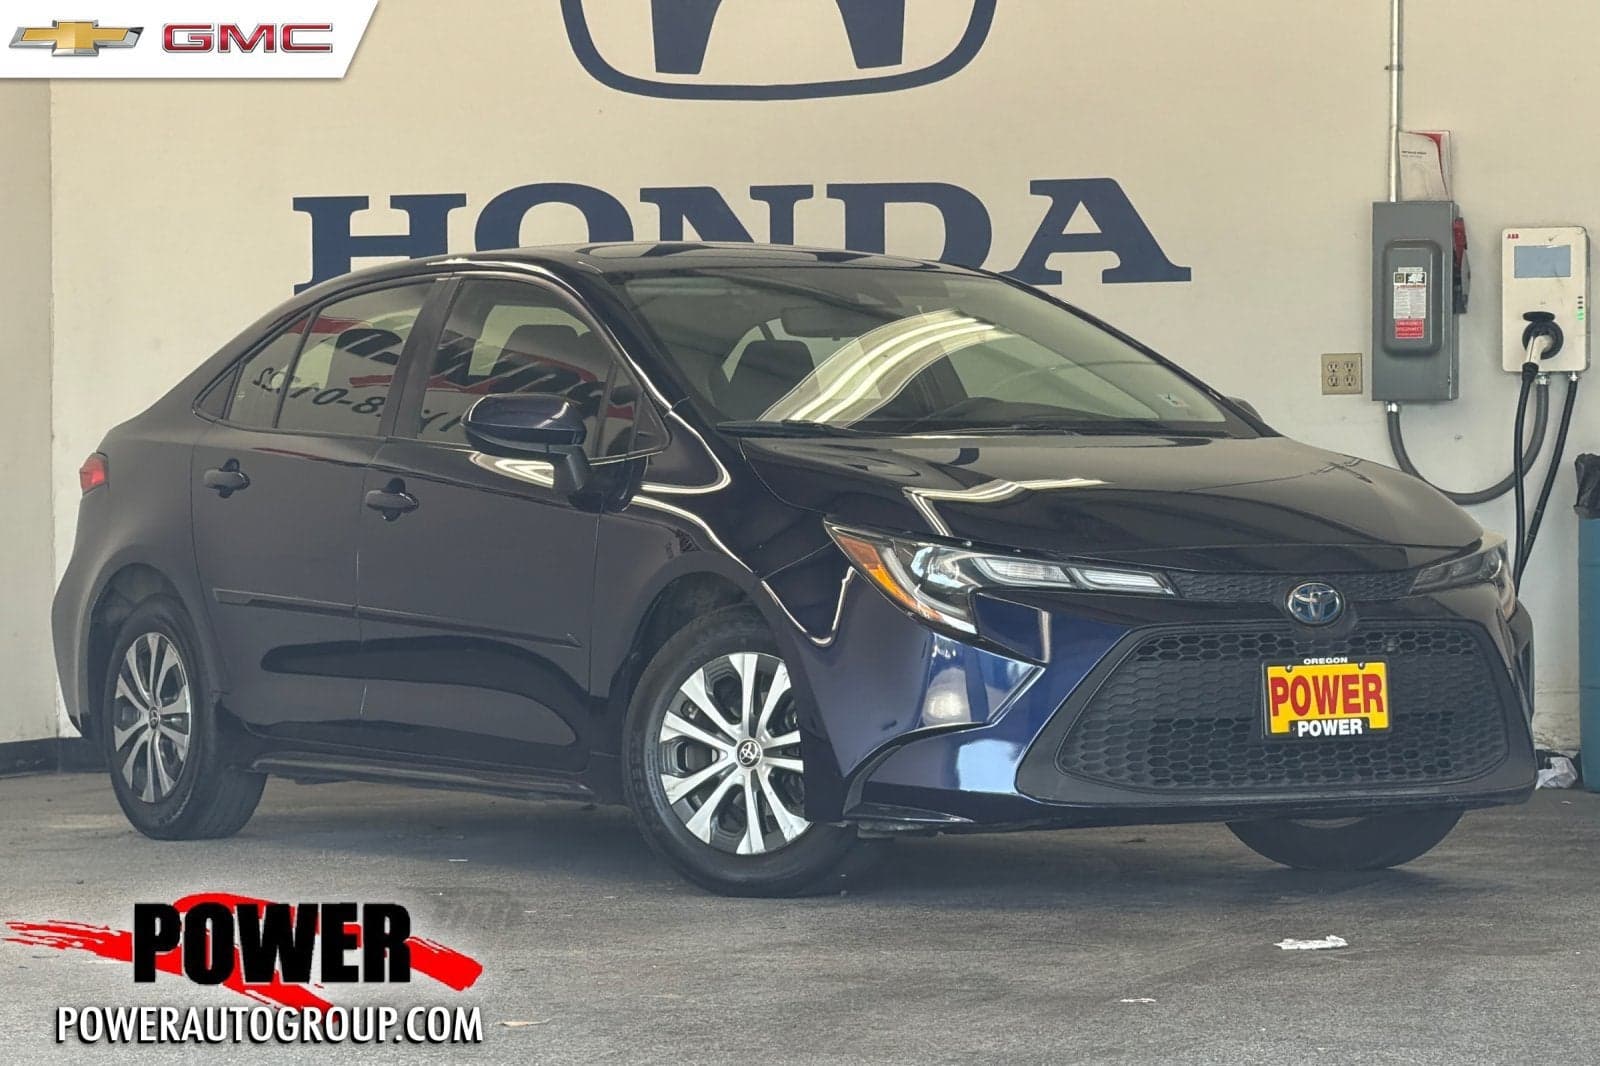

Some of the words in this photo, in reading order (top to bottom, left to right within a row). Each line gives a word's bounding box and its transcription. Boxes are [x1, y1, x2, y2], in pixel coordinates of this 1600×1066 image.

[293, 177, 1192, 295] HONDA
[1303, 656, 1349, 665] OREGON
[1270, 673, 1385, 717] POWER
[1297, 718, 1363, 738] POWER
